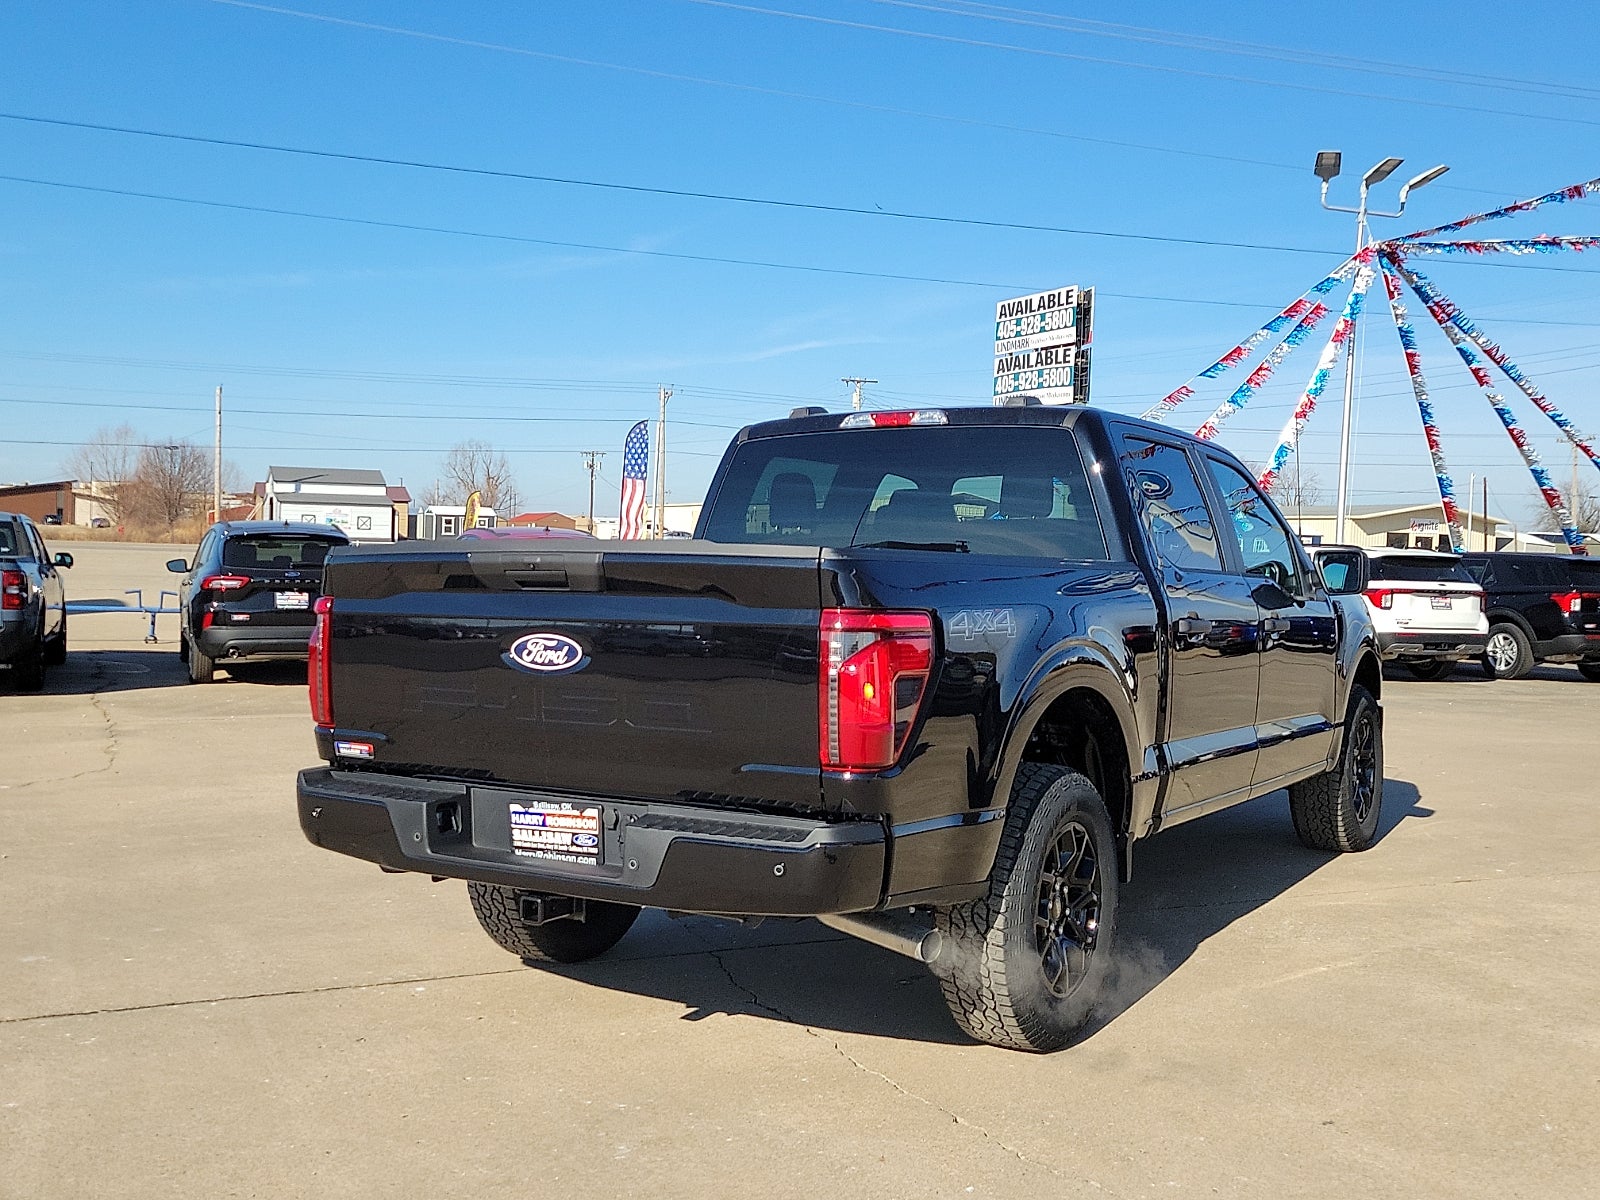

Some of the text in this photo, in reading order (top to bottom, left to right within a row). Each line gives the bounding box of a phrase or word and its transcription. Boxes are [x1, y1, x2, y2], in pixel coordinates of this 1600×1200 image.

[998, 288, 1075, 320] AVAILABLE
[996, 307, 1075, 340] 405-928-5800
[996, 347, 1072, 375] AVAILABLE
[994, 366, 1072, 394] 405-928-5800
[521, 638, 570, 665] Ford
